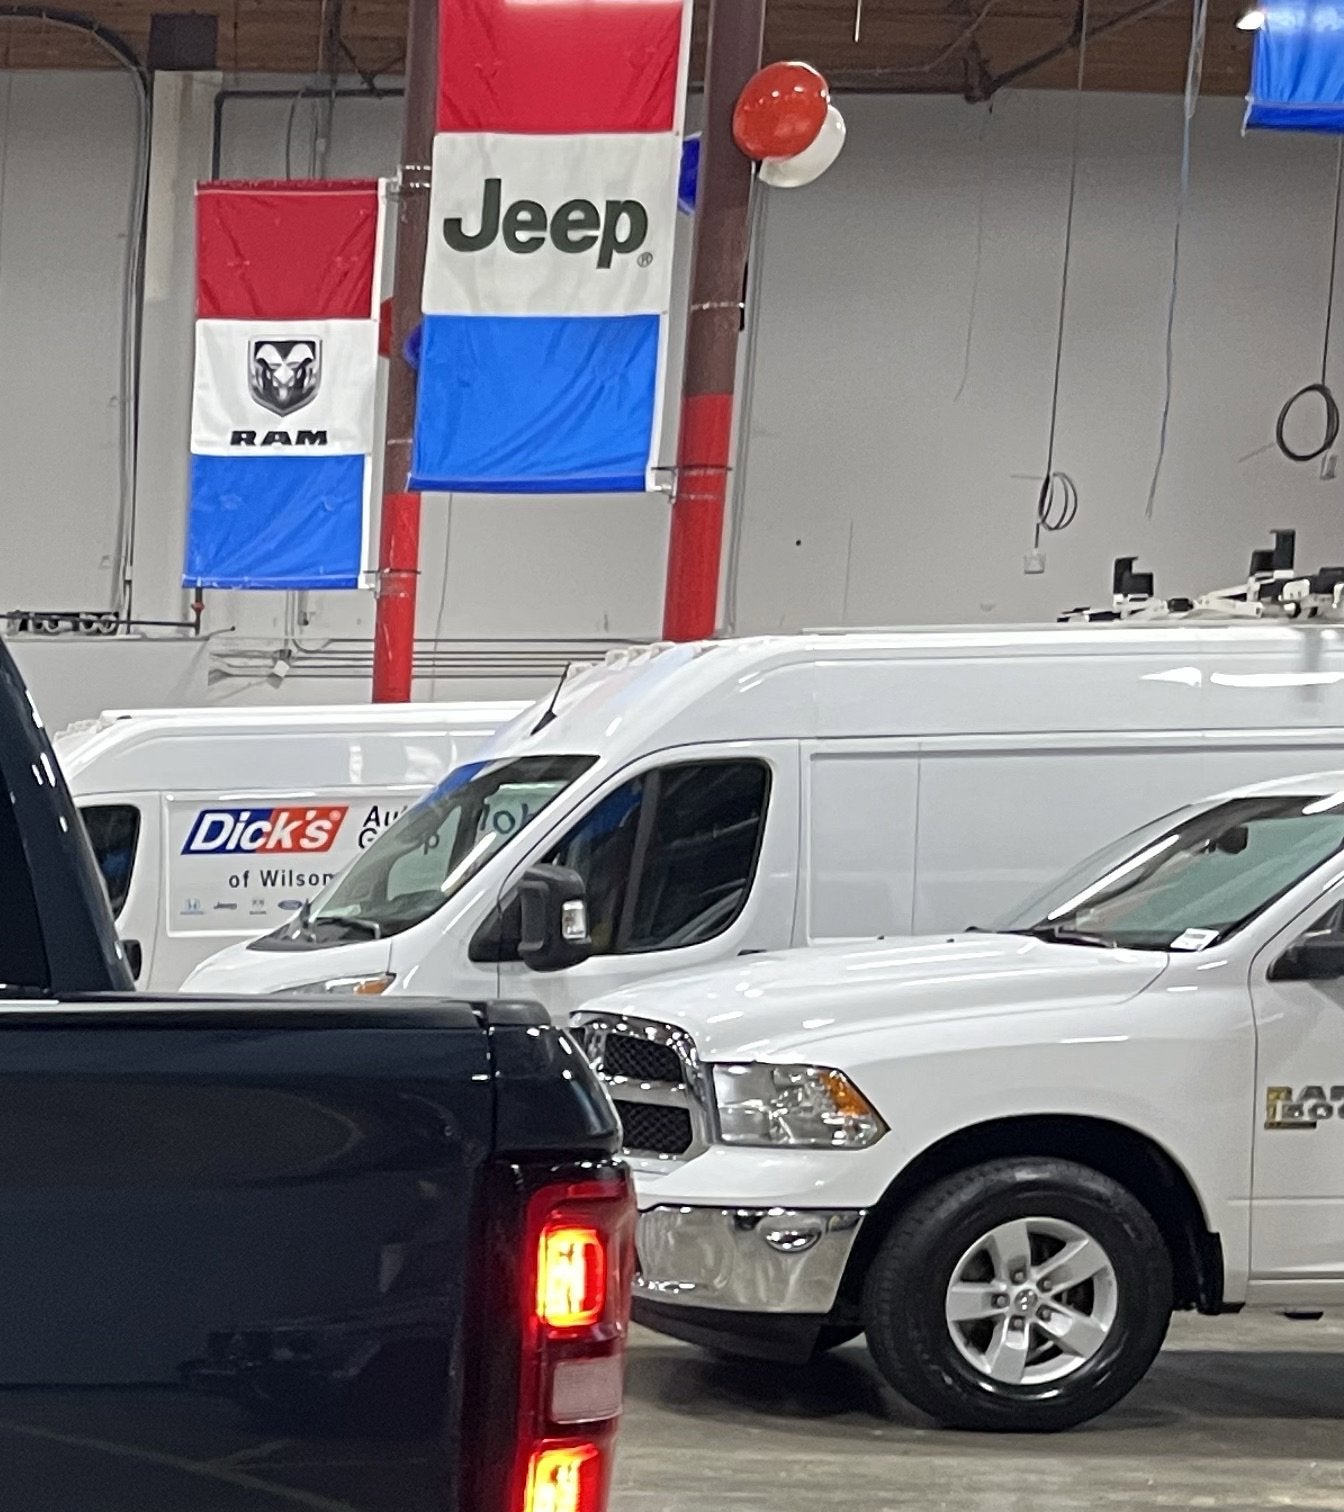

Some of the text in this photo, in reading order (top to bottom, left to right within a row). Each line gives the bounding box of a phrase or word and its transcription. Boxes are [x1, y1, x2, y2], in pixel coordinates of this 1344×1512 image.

[443, 178, 648, 269] Jeep
[230, 430, 328, 446] RAM
[190, 809, 333, 851] Dick's
[228, 868, 334, 888] of Wilson
